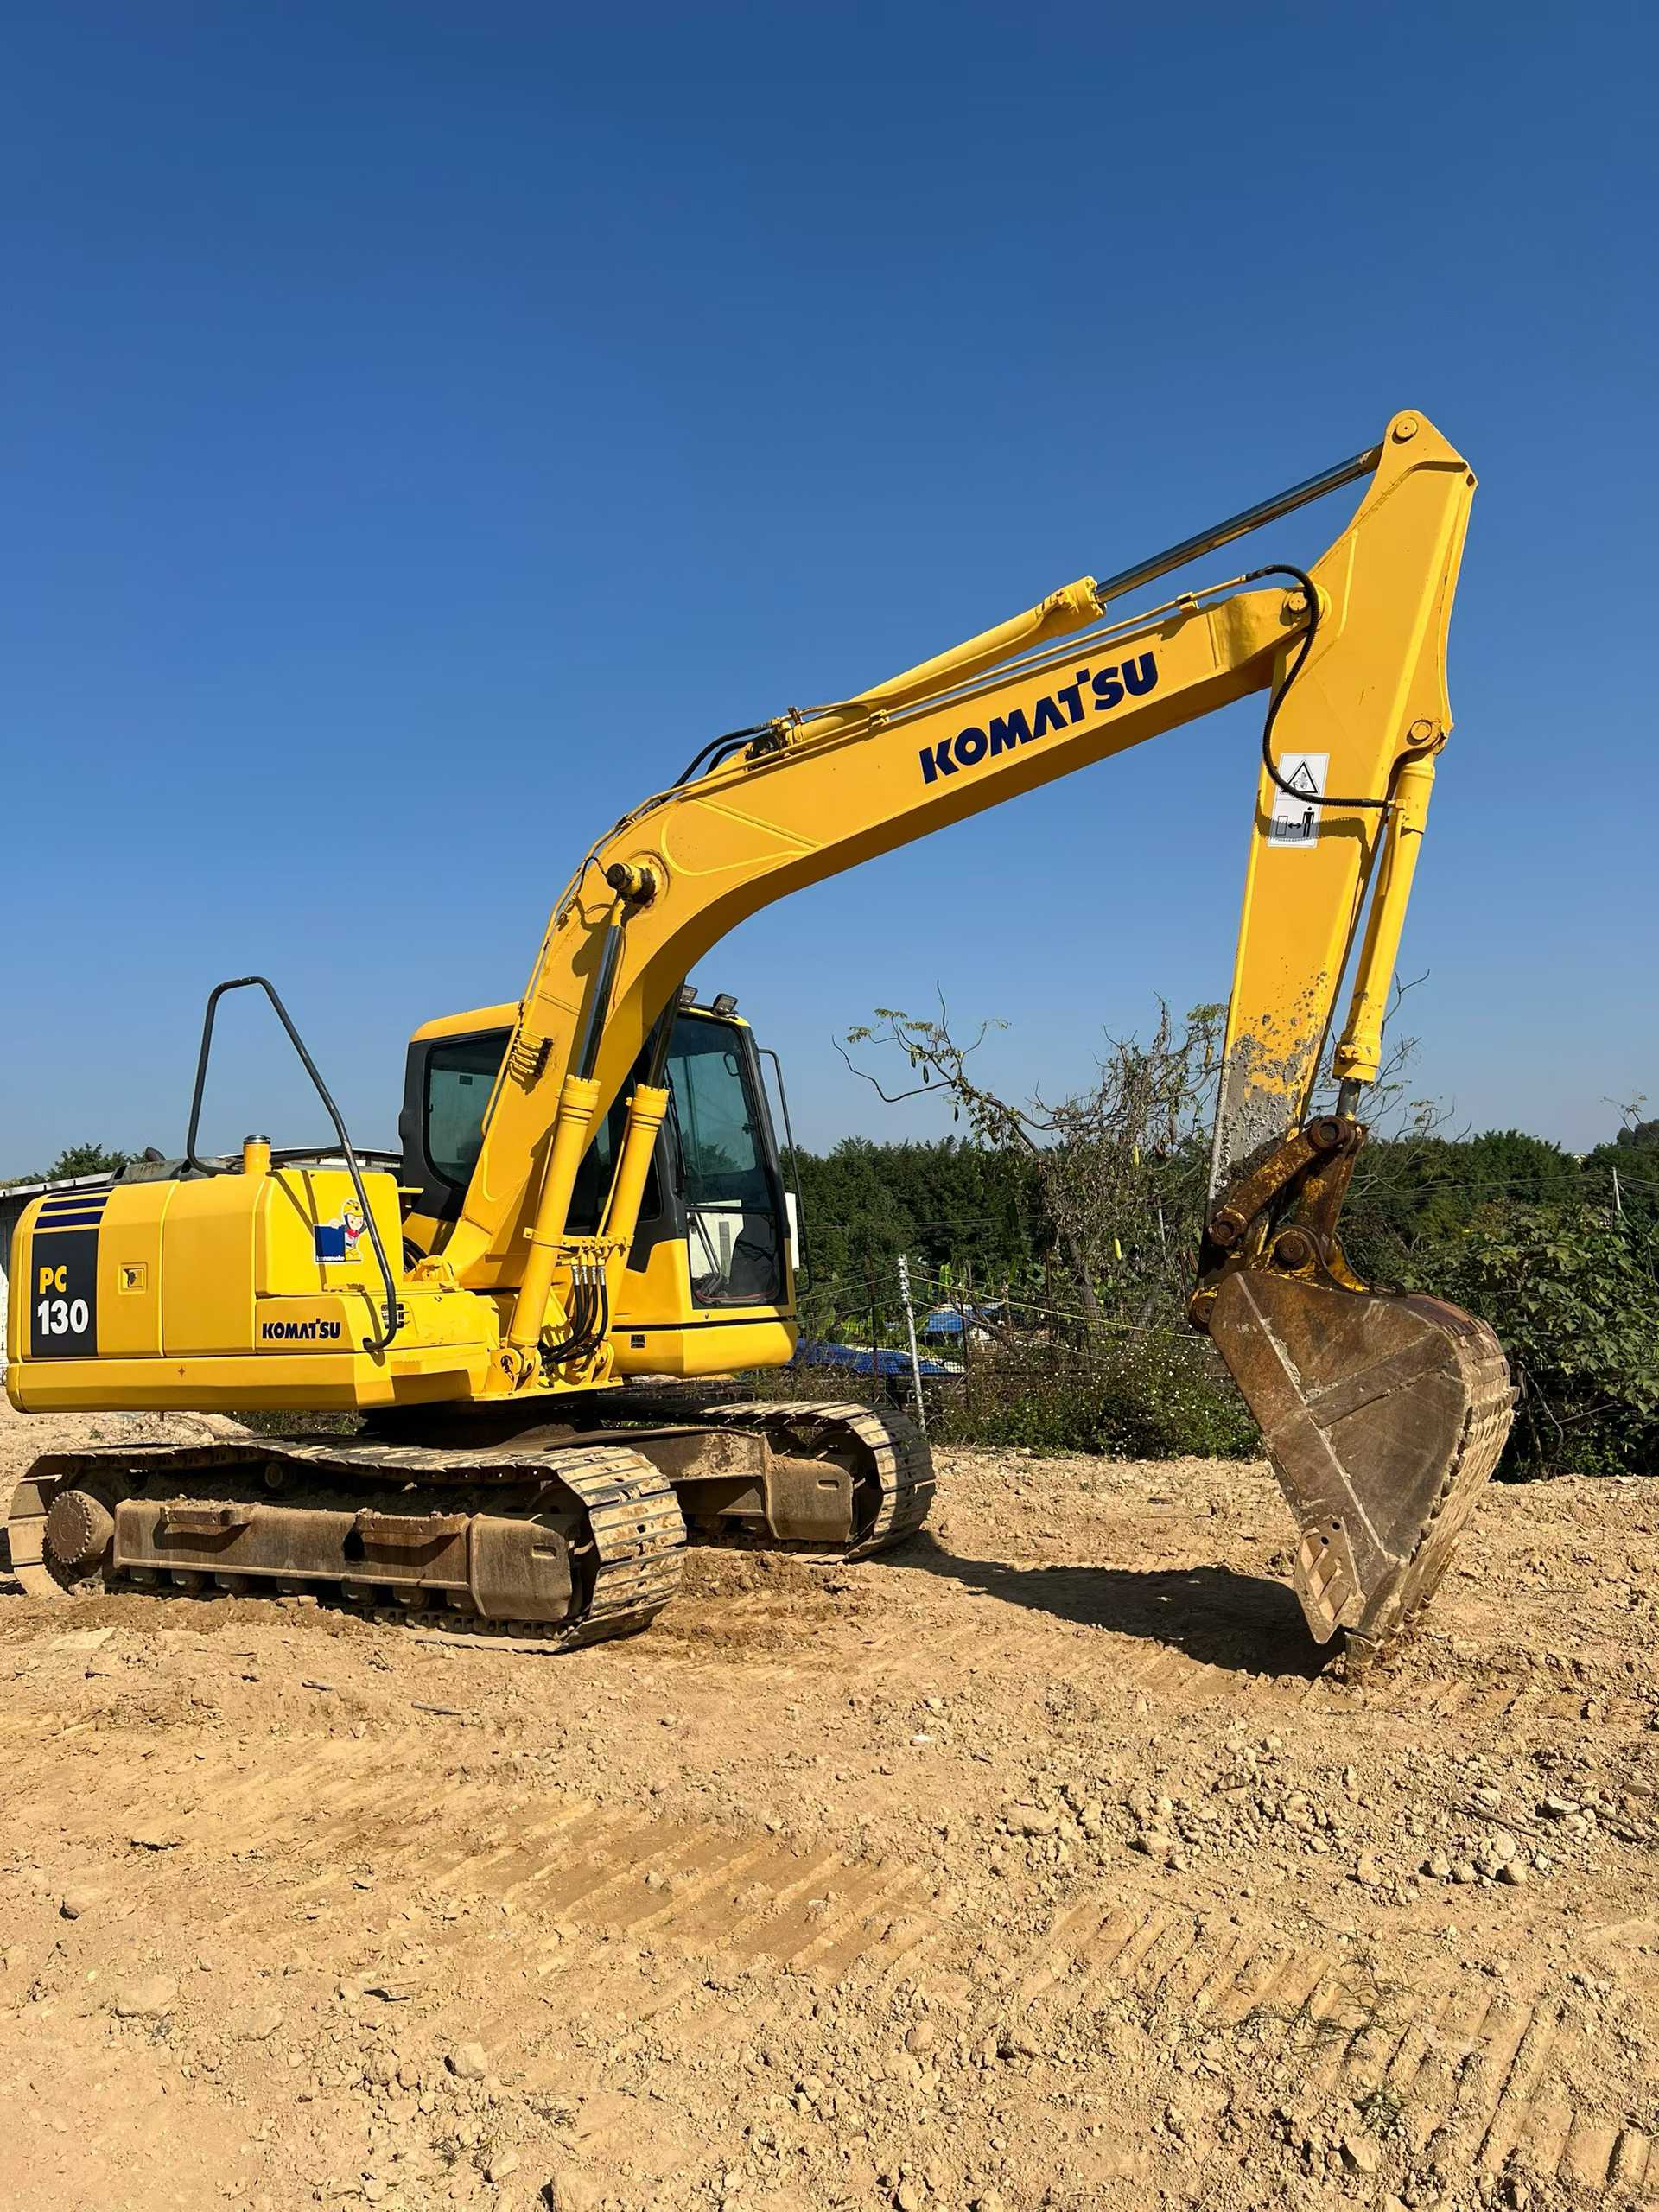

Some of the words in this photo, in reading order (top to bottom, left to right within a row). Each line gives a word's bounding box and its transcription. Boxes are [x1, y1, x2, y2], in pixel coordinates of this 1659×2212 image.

[918, 651, 1159, 785] KOMATSU
[39, 1265, 67, 1294] PC
[37, 1298, 89, 1335] 130
[262, 1318, 341, 1339] KOMATSU
